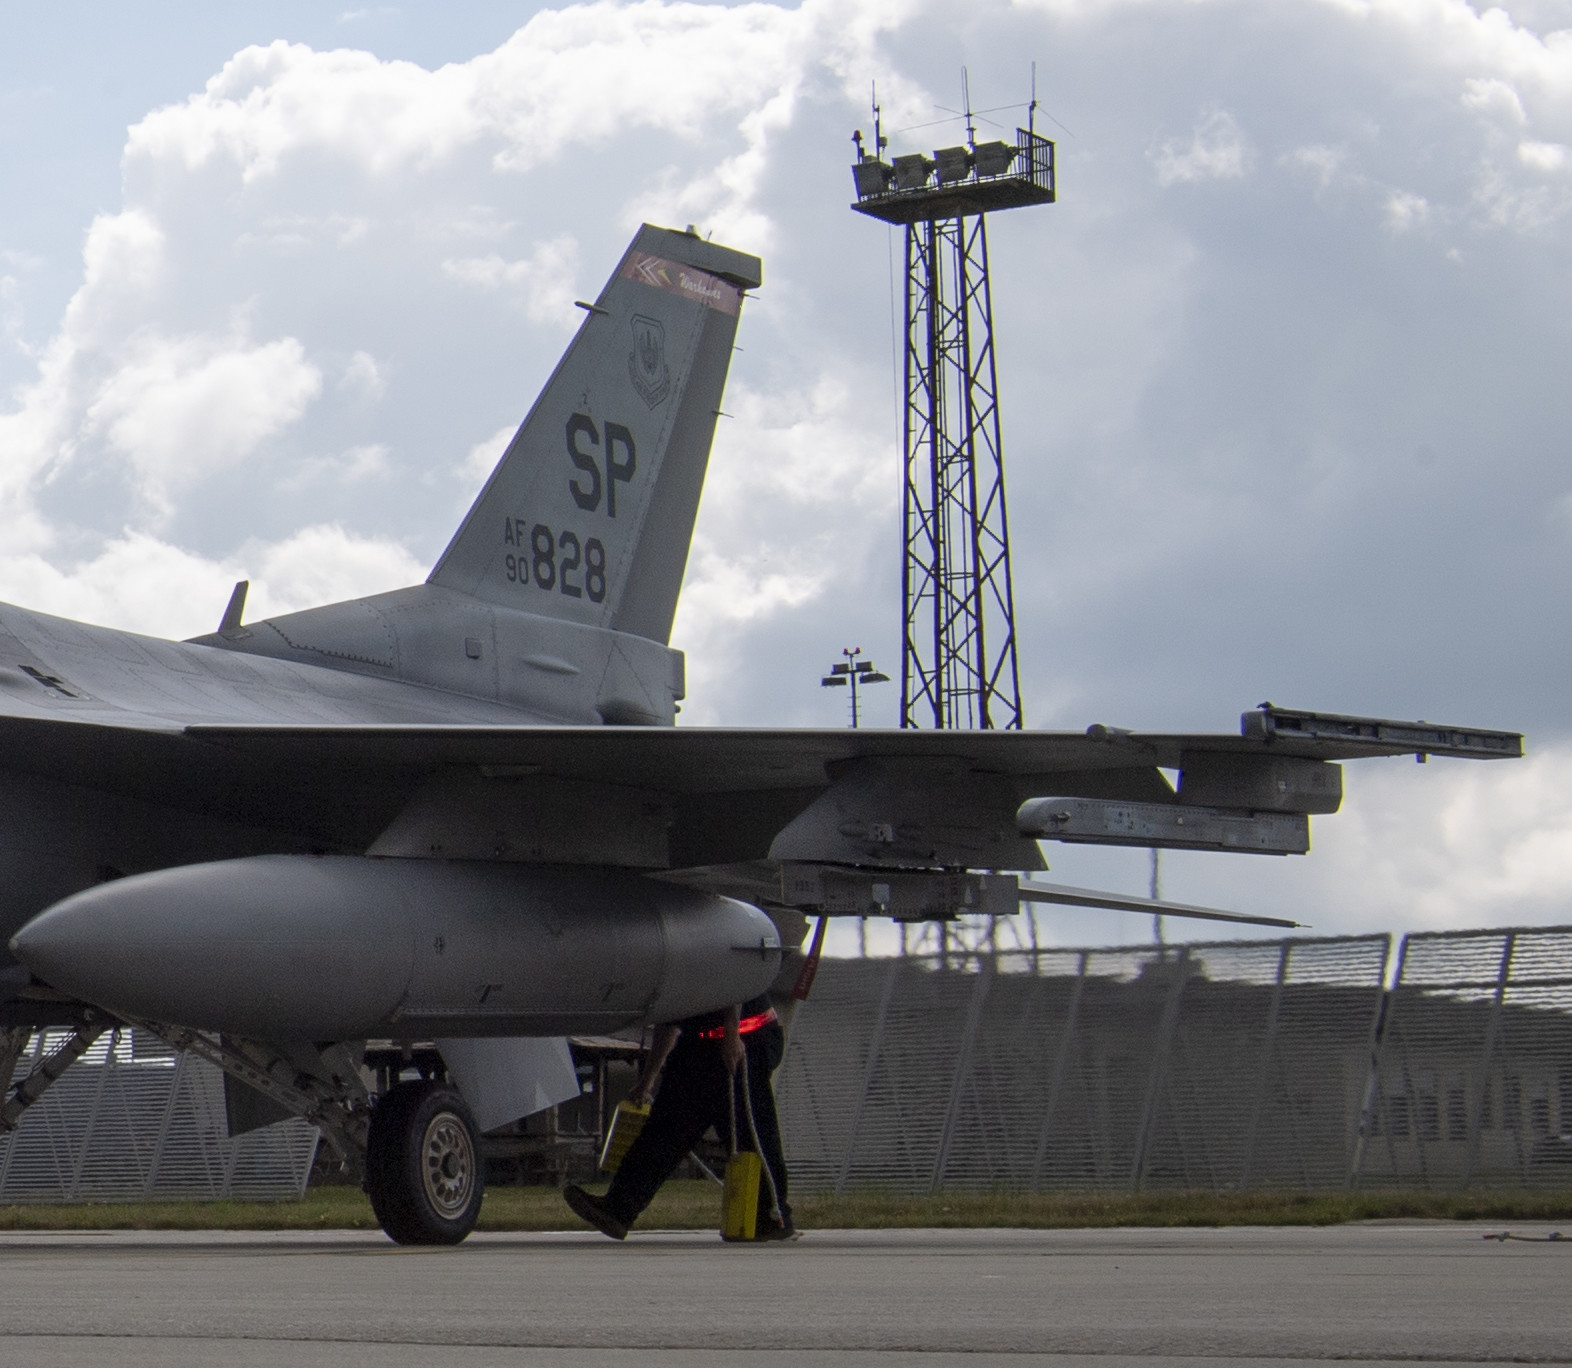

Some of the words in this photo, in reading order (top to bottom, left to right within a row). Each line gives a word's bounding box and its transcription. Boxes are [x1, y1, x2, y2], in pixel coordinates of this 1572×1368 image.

[565, 411, 637, 518] SP
[504, 516, 526, 547] AF
[505, 553, 529, 585] 90
[531, 523, 606, 603] 828
